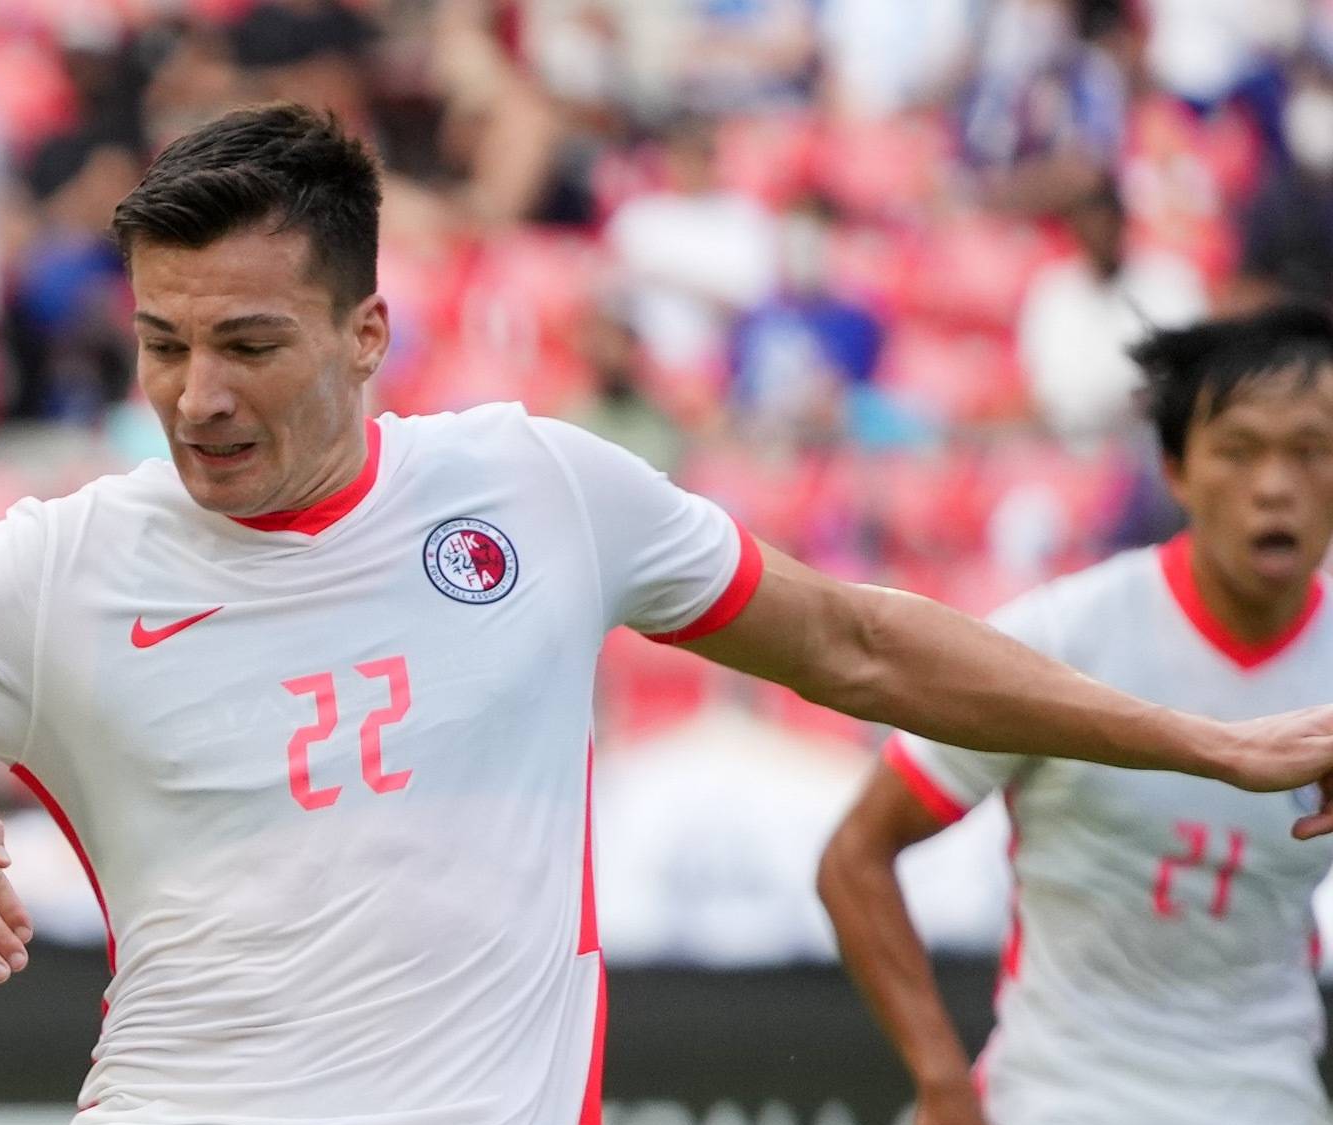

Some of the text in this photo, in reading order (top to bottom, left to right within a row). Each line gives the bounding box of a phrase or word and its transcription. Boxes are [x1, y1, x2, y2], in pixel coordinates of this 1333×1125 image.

[429, 564, 467, 599] FOOTBALL
[279, 655, 414, 812] 22
[1152, 820, 1249, 920] 21
